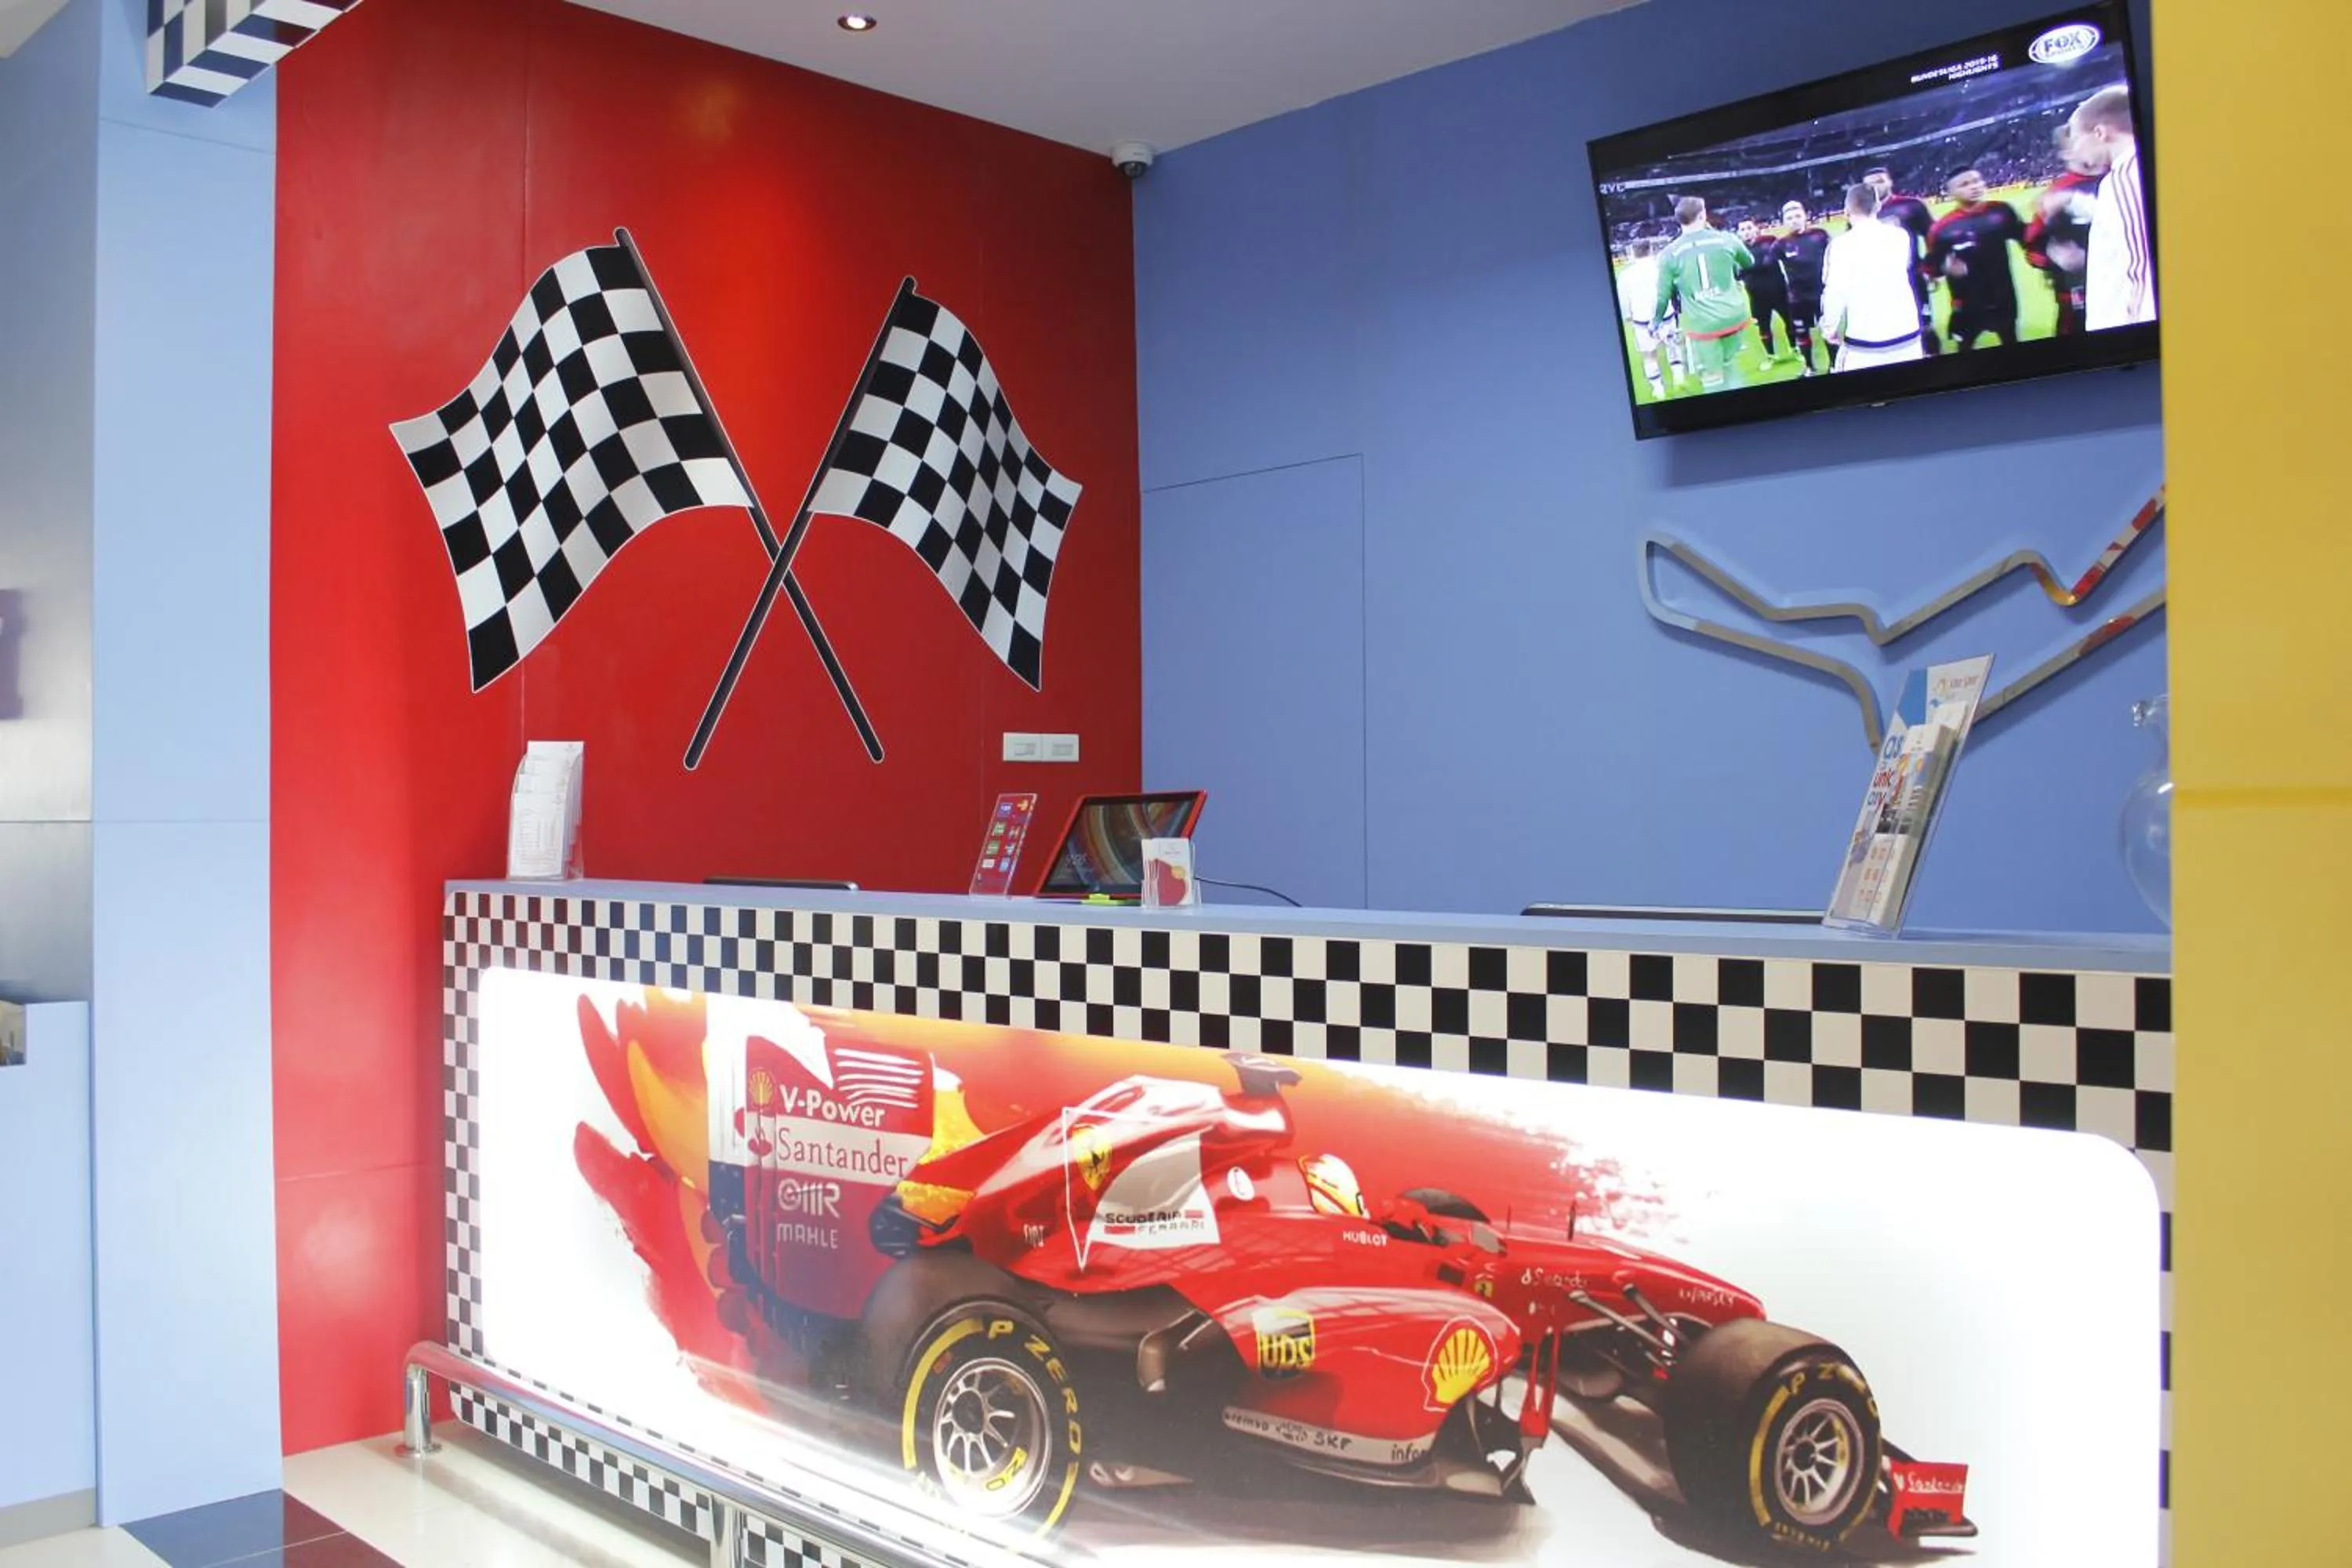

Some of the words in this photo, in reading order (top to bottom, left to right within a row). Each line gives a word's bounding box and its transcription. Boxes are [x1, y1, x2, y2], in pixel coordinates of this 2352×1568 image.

[2044, 31, 2082, 53] FOX
[779, 1084, 885, 1127] V-Power
[778, 1127, 909, 1178] Santander
[777, 1223, 838, 1249] MAHLE
[1342, 1230, 1388, 1247] HUBLOT
[988, 1319, 1014, 1340] P
